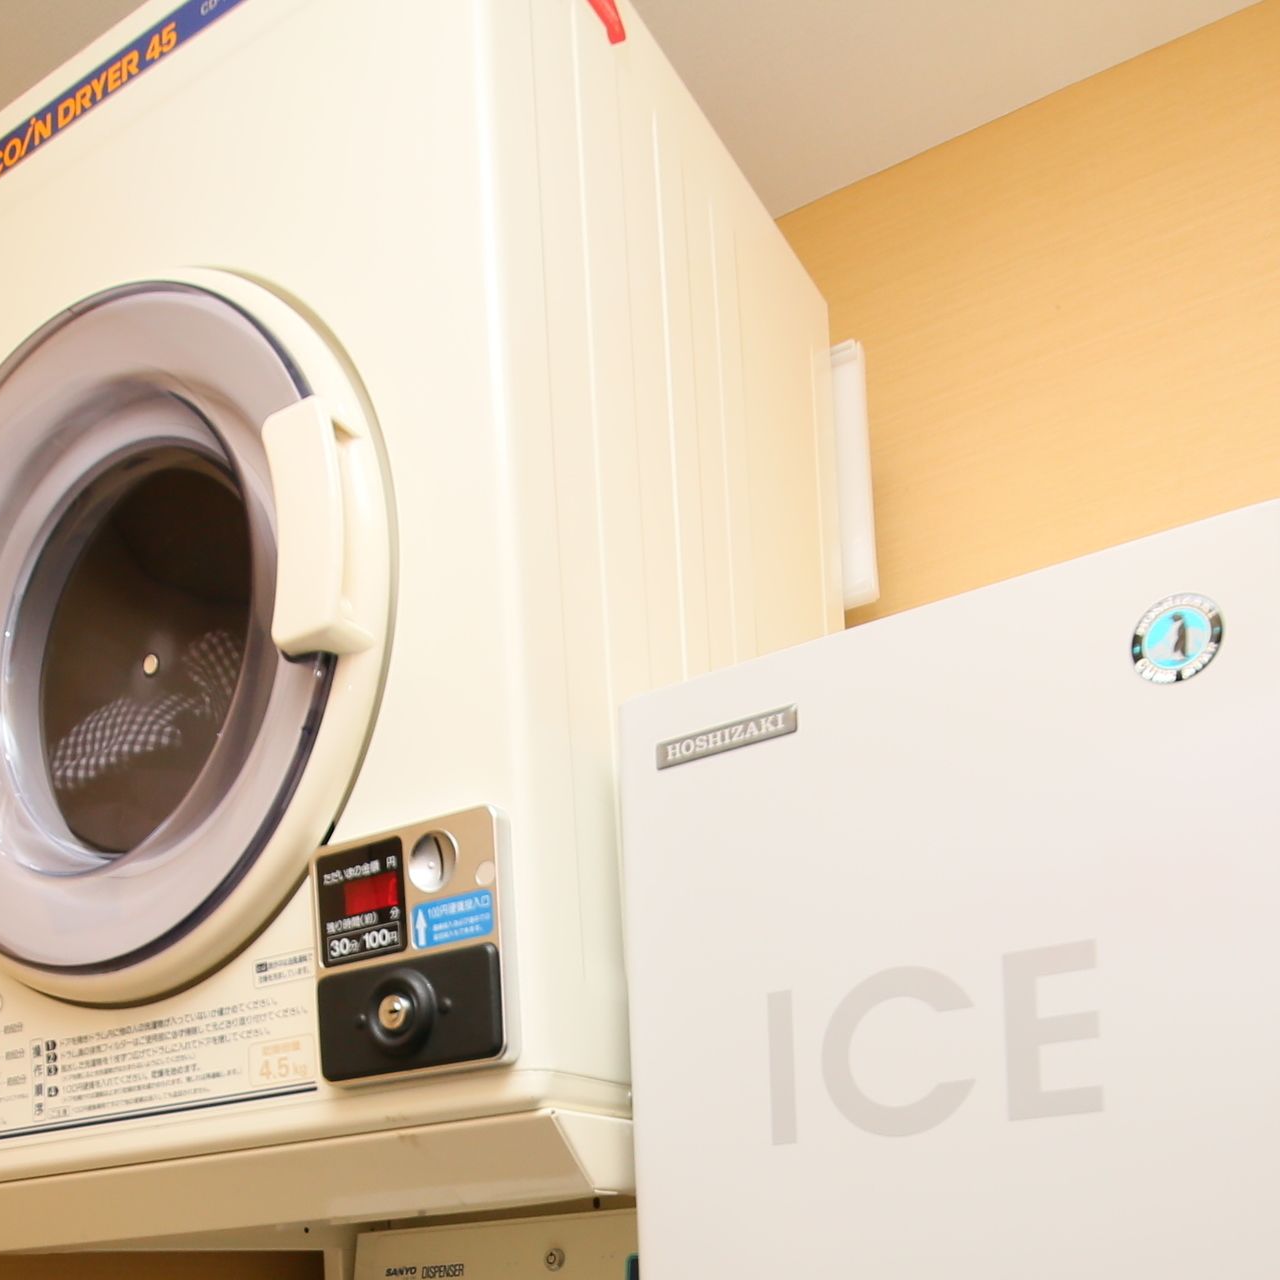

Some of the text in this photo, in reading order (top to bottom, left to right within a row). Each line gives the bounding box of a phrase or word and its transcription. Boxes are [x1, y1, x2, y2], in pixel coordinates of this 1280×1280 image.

[57, 56, 141, 131] DRYER
[145, 22, 179, 60] 45
[666, 712, 786, 761] HOSHIZAKI
[766, 938, 1106, 1146] ICE
[384, 1262, 465, 1280] SANYO DISPENSER
